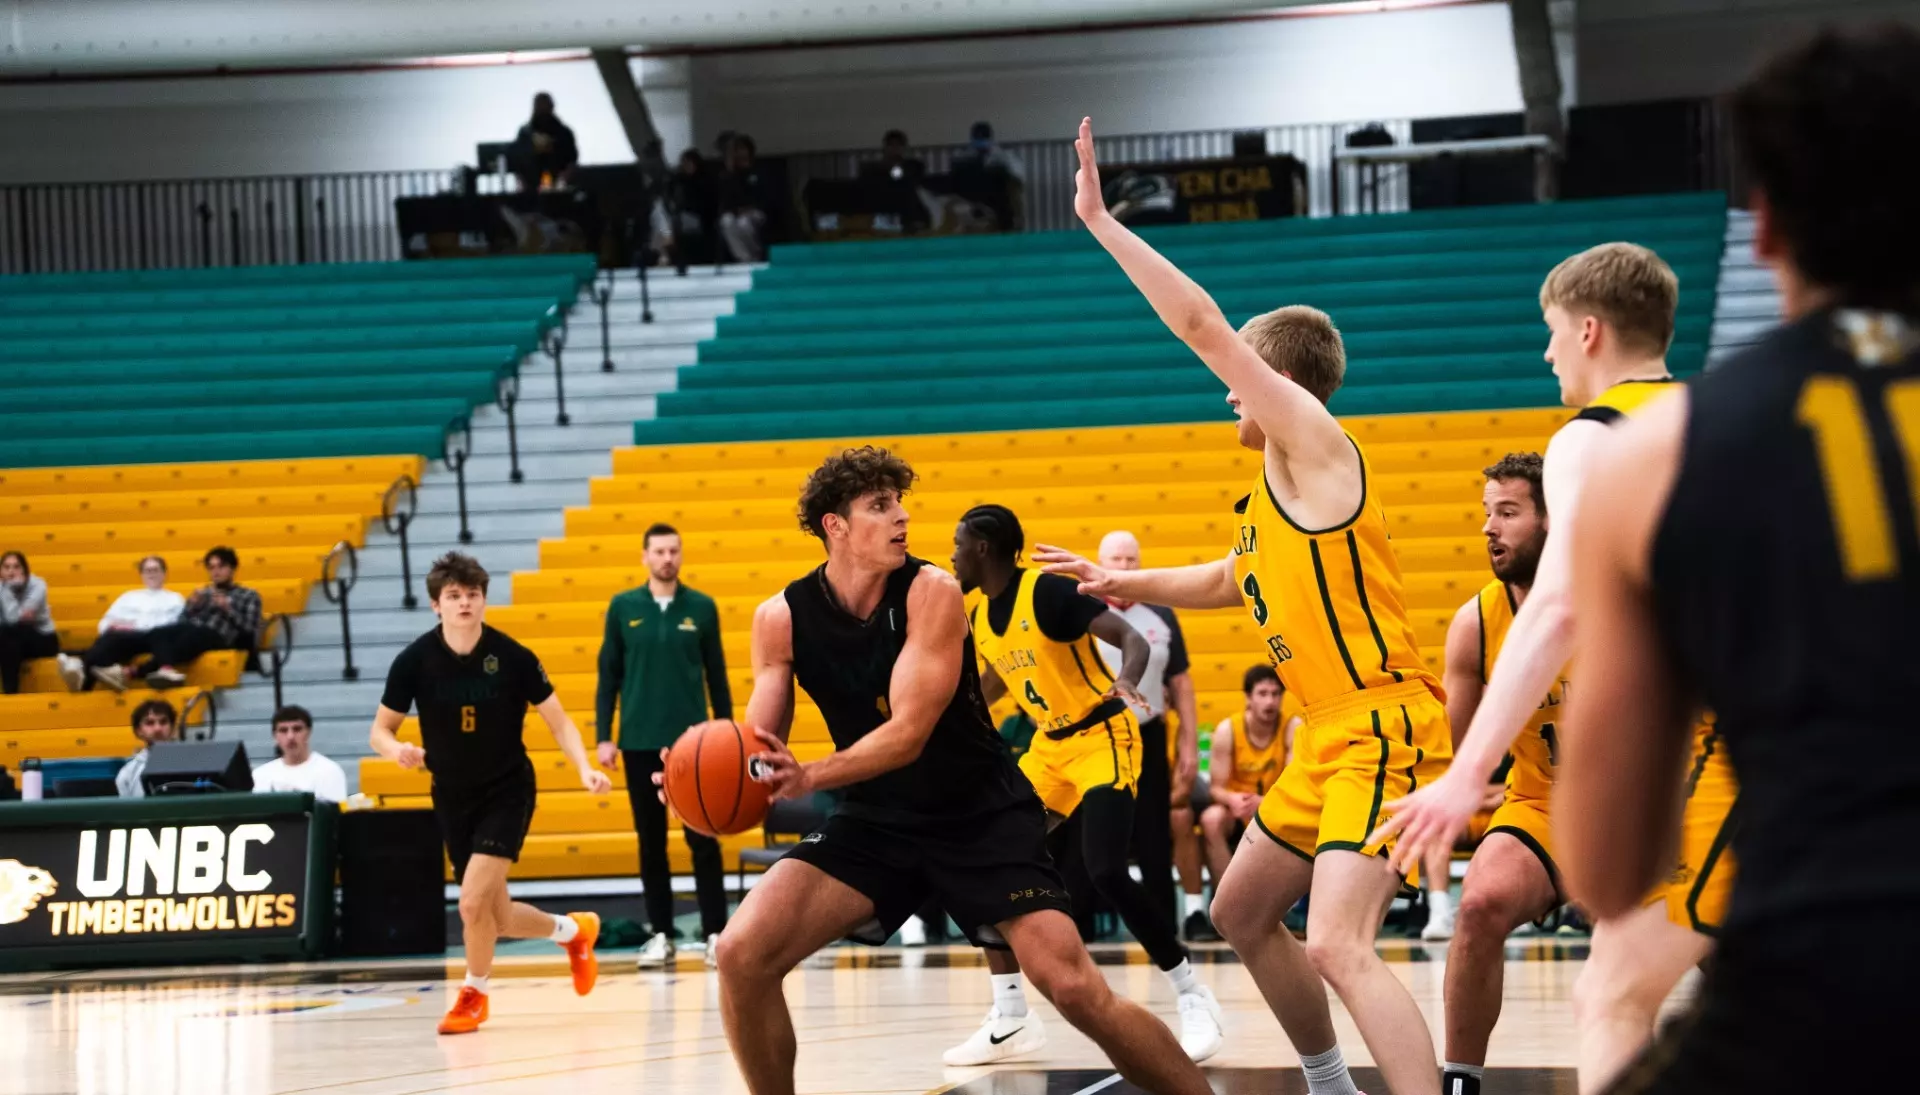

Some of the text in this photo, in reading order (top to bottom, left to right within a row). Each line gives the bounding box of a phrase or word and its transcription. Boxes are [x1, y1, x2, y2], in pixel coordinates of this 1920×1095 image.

[1024, 678, 1049, 712] 4
[461, 705, 476, 733] 6
[76, 823, 275, 898] UNBC
[48, 894, 297, 936] TIMBERWOLVES
